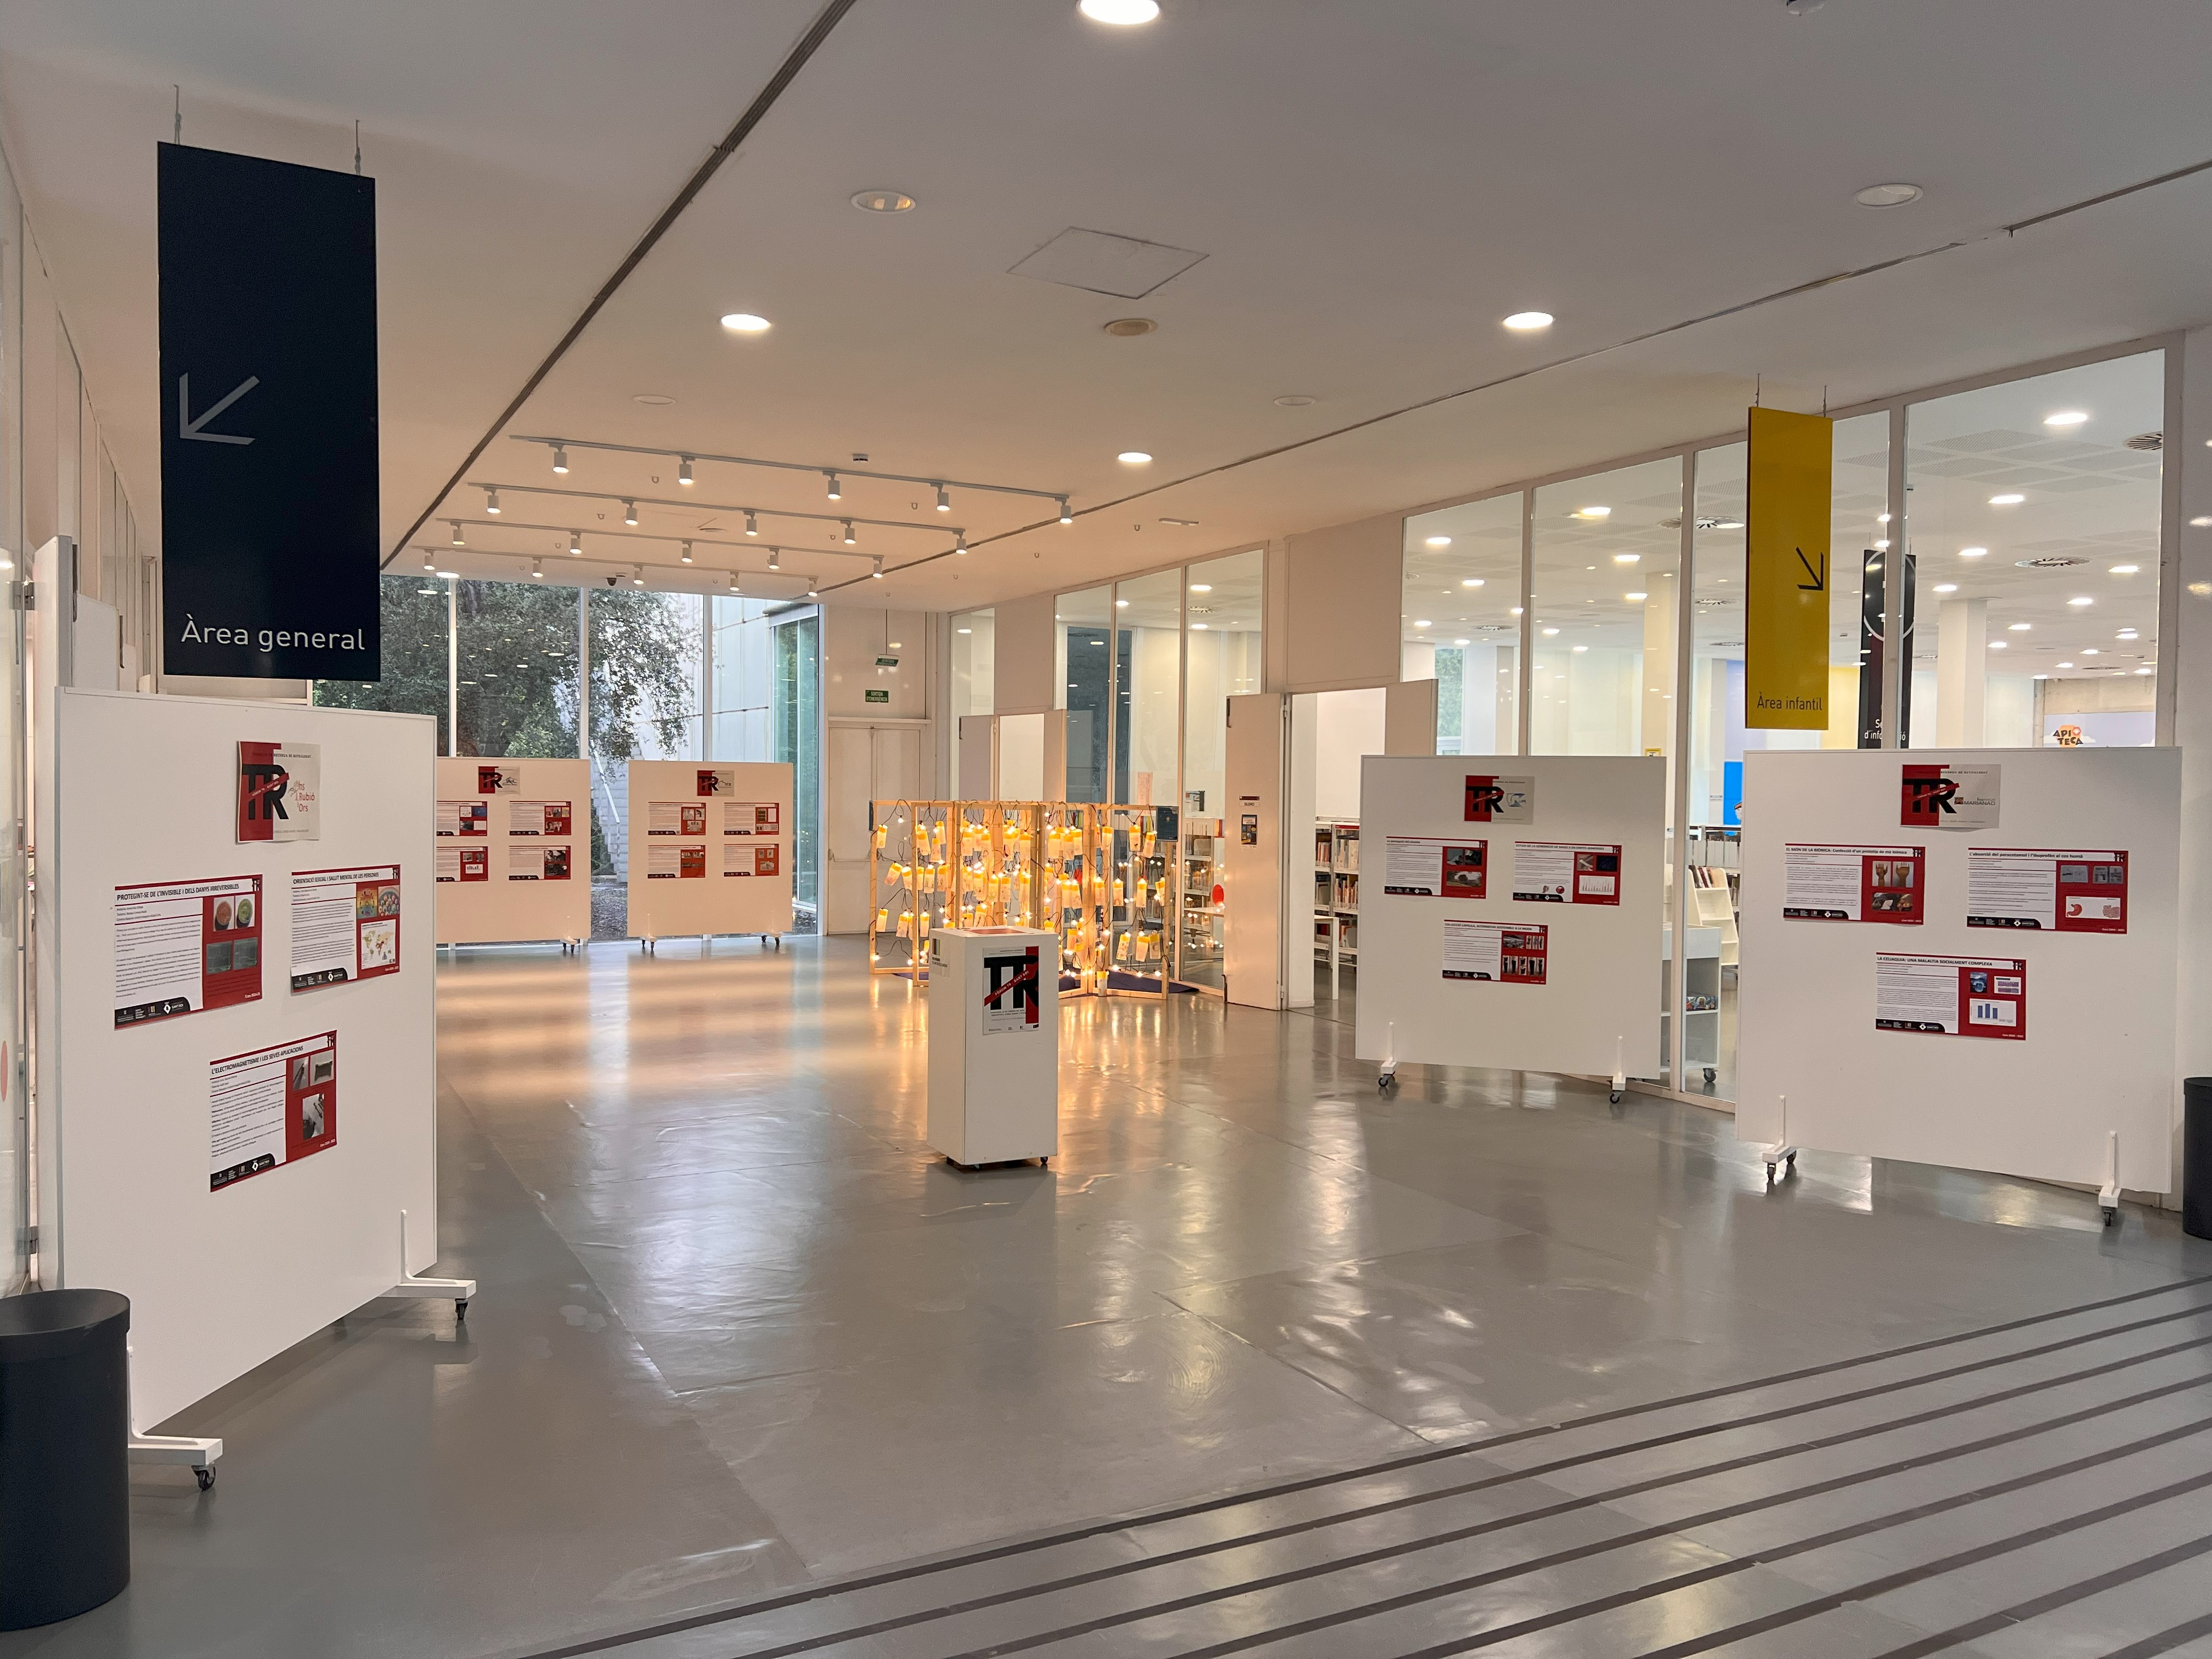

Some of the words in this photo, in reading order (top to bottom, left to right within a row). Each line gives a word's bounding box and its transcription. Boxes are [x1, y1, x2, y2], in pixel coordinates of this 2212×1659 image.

[180, 613, 249, 645] Àrea
[258, 629, 365, 652] general
[1757, 691, 1782, 709] Àrea
[1786, 696, 1822, 710] infantil
[2057, 737, 2084, 745] TECA
[117, 891, 149, 901] PROTEGINT-SE
[157, 889, 181, 897] L'INVISIBLE
[210, 883, 239, 891] IRREVERSIBLES
[211, 1058, 259, 1074] L'ELECTROMAGNETISME
[269, 1051, 280, 1060] SEVES
